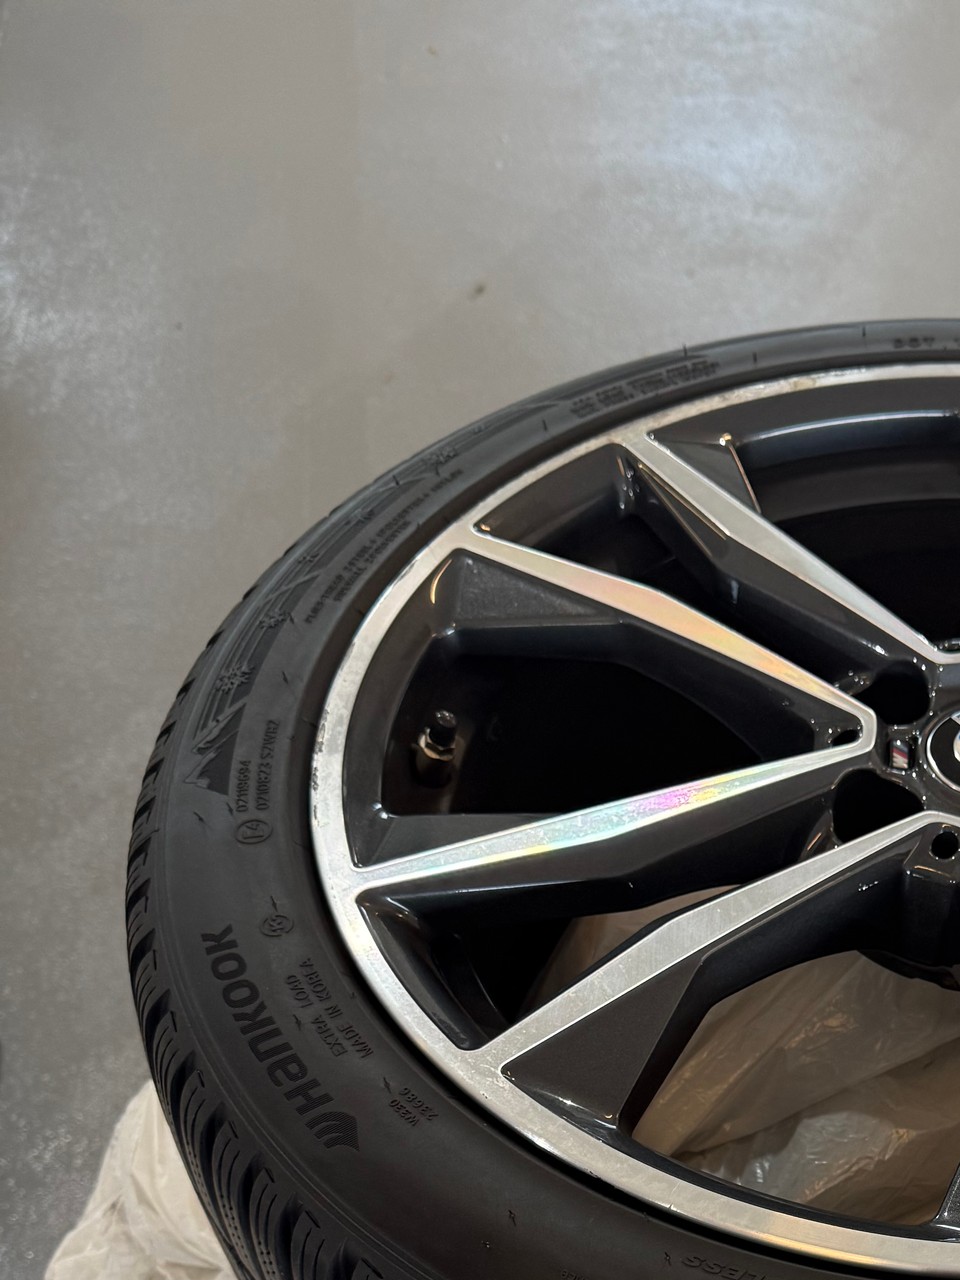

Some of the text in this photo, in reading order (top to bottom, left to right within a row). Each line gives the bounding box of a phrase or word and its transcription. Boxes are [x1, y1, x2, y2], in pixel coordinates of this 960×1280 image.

[285, 973, 349, 1058] EXTRA LOAD
[299, 957, 375, 1059] MADE IN KOREA
